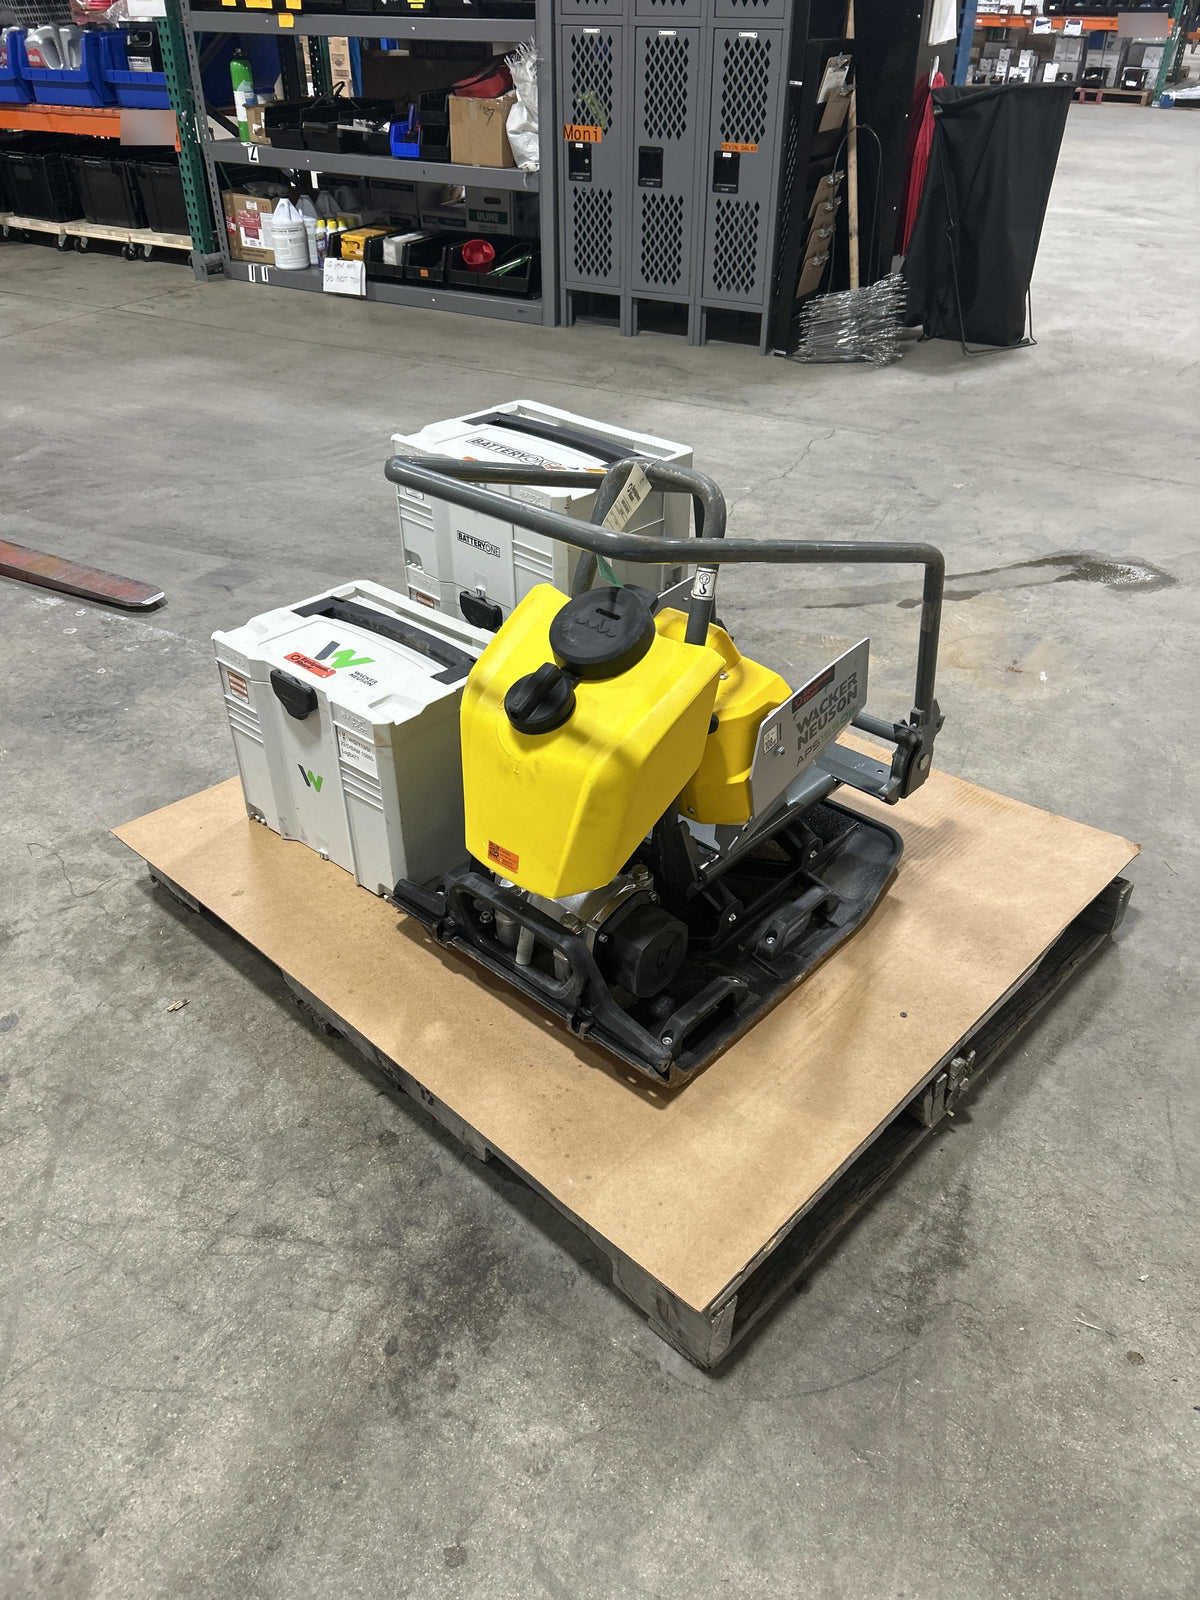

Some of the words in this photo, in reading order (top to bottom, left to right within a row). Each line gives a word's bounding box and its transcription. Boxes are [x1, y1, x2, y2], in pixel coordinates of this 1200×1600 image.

[563, 125, 598, 141] Moni
[476, 210, 499, 223] ULINE
[458, 531, 500, 557] BATTERYONE
[795, 672, 858, 733] WACKER
[797, 685, 858, 751] NEUSON
